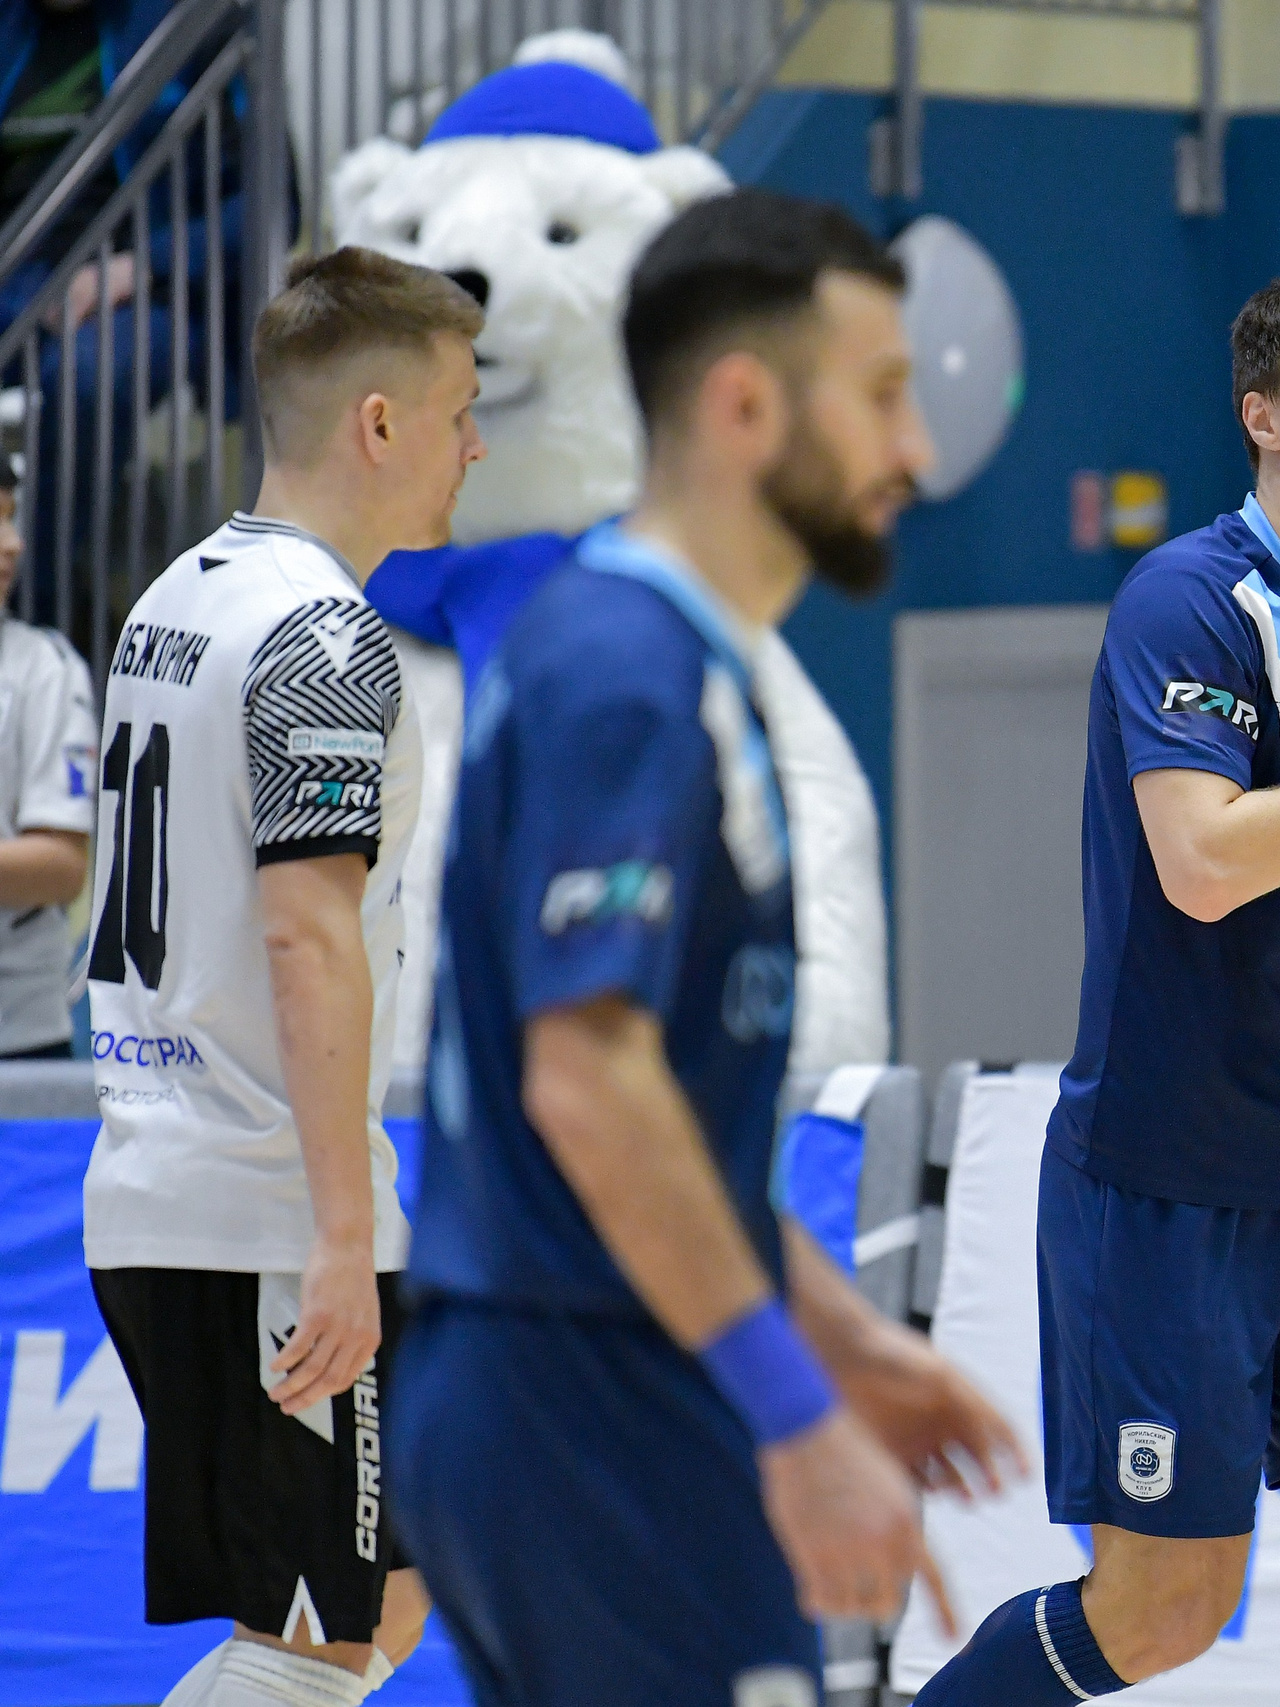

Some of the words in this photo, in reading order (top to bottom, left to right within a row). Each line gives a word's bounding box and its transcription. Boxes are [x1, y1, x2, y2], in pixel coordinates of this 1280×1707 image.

[294, 780, 374, 808] PARI
[87, 721, 170, 991] 10
[91, 1030, 205, 1068] ОССТРАХ
